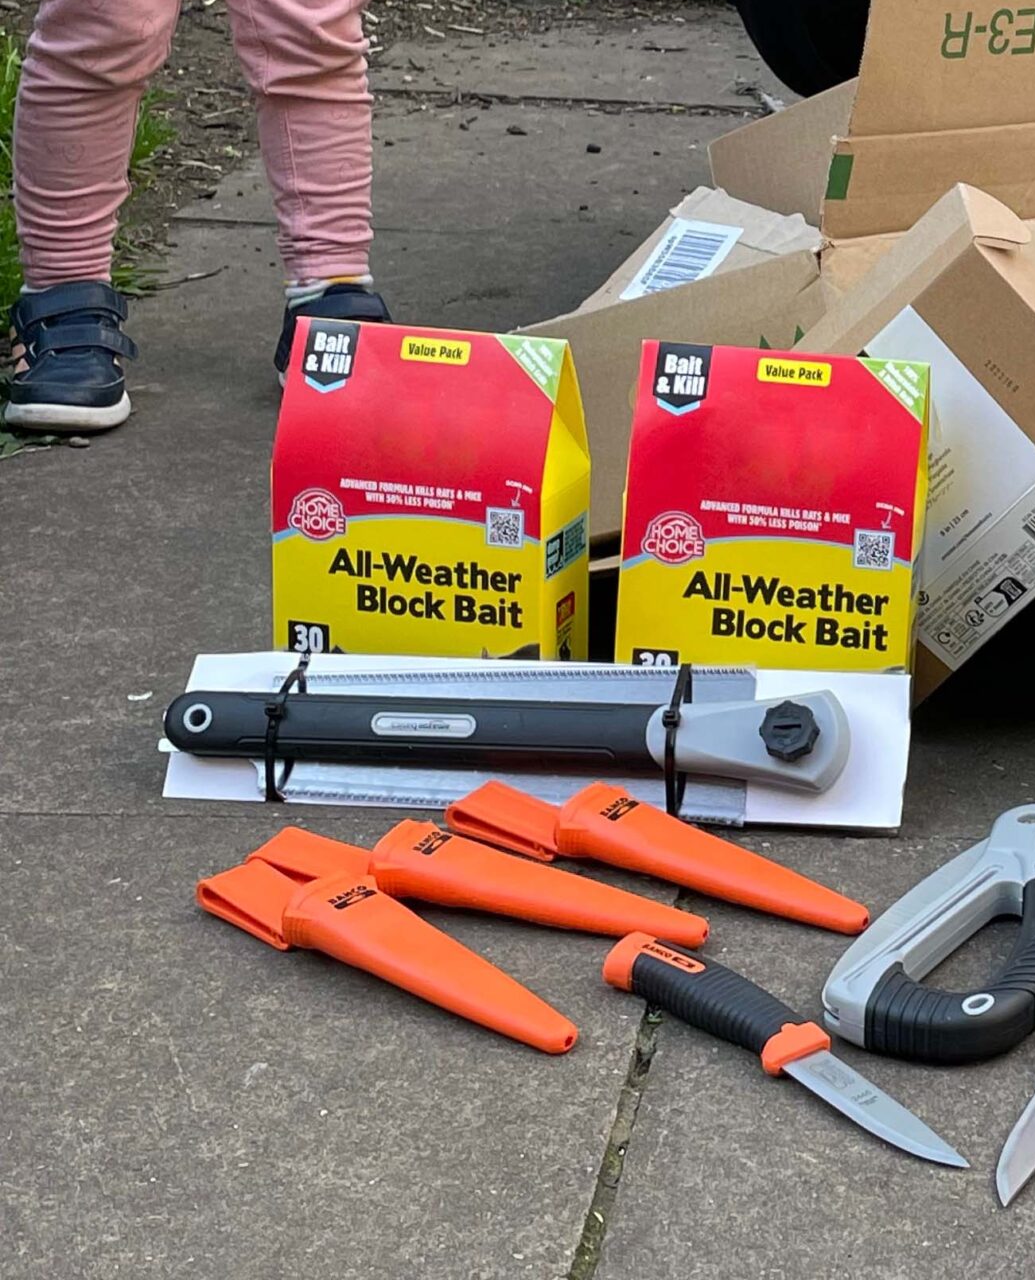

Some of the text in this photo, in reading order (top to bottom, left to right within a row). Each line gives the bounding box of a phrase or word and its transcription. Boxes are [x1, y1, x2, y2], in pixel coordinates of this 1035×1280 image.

[314, 331, 350, 354] Bait
[408, 343, 463, 360] Value Pack
[305, 354, 352, 375] & Kill
[665, 354, 702, 376] Bait
[765, 365, 823, 381] Value Pack
[656, 375, 704, 397] & Kill
[340, 478, 482, 502] ADVANCED FORMULA KILLS RATS & MICE
[366, 491, 385, 501] WITH
[386, 493, 402, 503] 50%
[404, 495, 421, 506] LESS
[297, 500, 339, 517] HOME
[700, 500, 850, 524] ADVANCED FORMULA KILLS RATS & MICE
[291, 514, 344, 532] CHOICE
[652, 524, 698, 540] HOME
[728, 514, 748, 524] WITH
[749, 515, 767, 527] 50%
[769, 518, 787, 528] LESS
[645, 538, 703, 555] CHOICE
[328, 548, 521, 594] All-Weather
[682, 571, 889, 615] All-Weather
[357, 584, 445, 620] Block
[455, 595, 523, 628] Bait
[294, 623, 324, 652] 30
[712, 608, 887, 651] Block Bait
[600, 796, 628, 818] BAHCO
[327, 885, 367, 905] BAHCO
